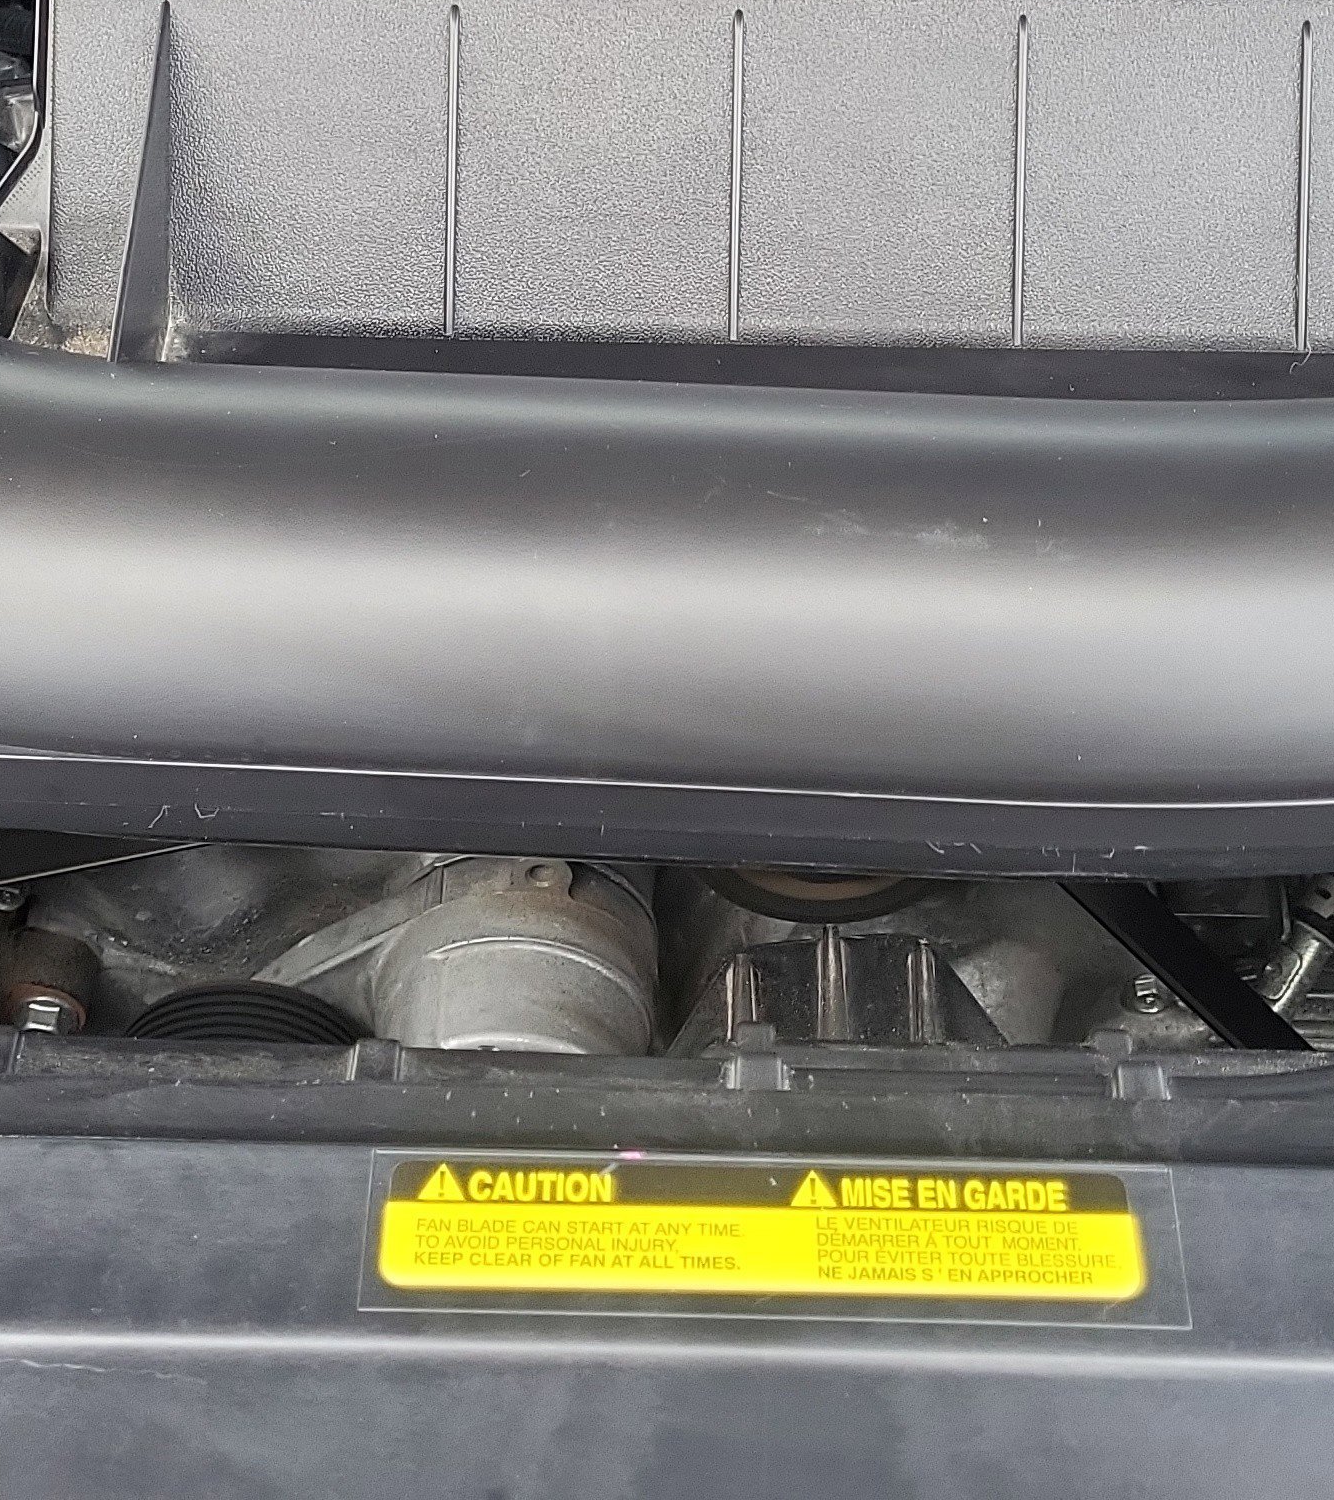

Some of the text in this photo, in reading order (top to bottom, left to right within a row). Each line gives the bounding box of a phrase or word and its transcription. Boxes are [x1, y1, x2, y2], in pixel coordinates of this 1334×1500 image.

[468, 1170, 613, 1203] CAUTION
[840, 1177, 1067, 1212] MISE EN GARDE
[416, 1218, 451, 1233] FAN
[457, 1219, 516, 1234] BLADE
[523, 1220, 561, 1234] CAN
[567, 1222, 623, 1234] START
[629, 1222, 651, 1235] AT
[656, 1222, 692, 1235] ANY
[816, 1216, 1078, 1235] LE VENTILATEUR RISQUE DE
[415, 1234, 440, 1248] TO
[445, 1235, 499, 1250] AVOID
[506, 1236, 605, 1251] PERSONAL
[942, 1235, 992, 1249] TOUT
[414, 1251, 741, 1270] KEEP CLEAR OF FAN AT ALL TIMES.
[818, 1249, 869, 1263] POUR
[877, 1246, 944, 1265] ÉVITER
[949, 1251, 1011, 1266] TOUTE
[819, 1266, 842, 1280] NE
[848, 1267, 917, 1281] JAMAIS
[978, 1269, 1093, 1284] APPROCHER
